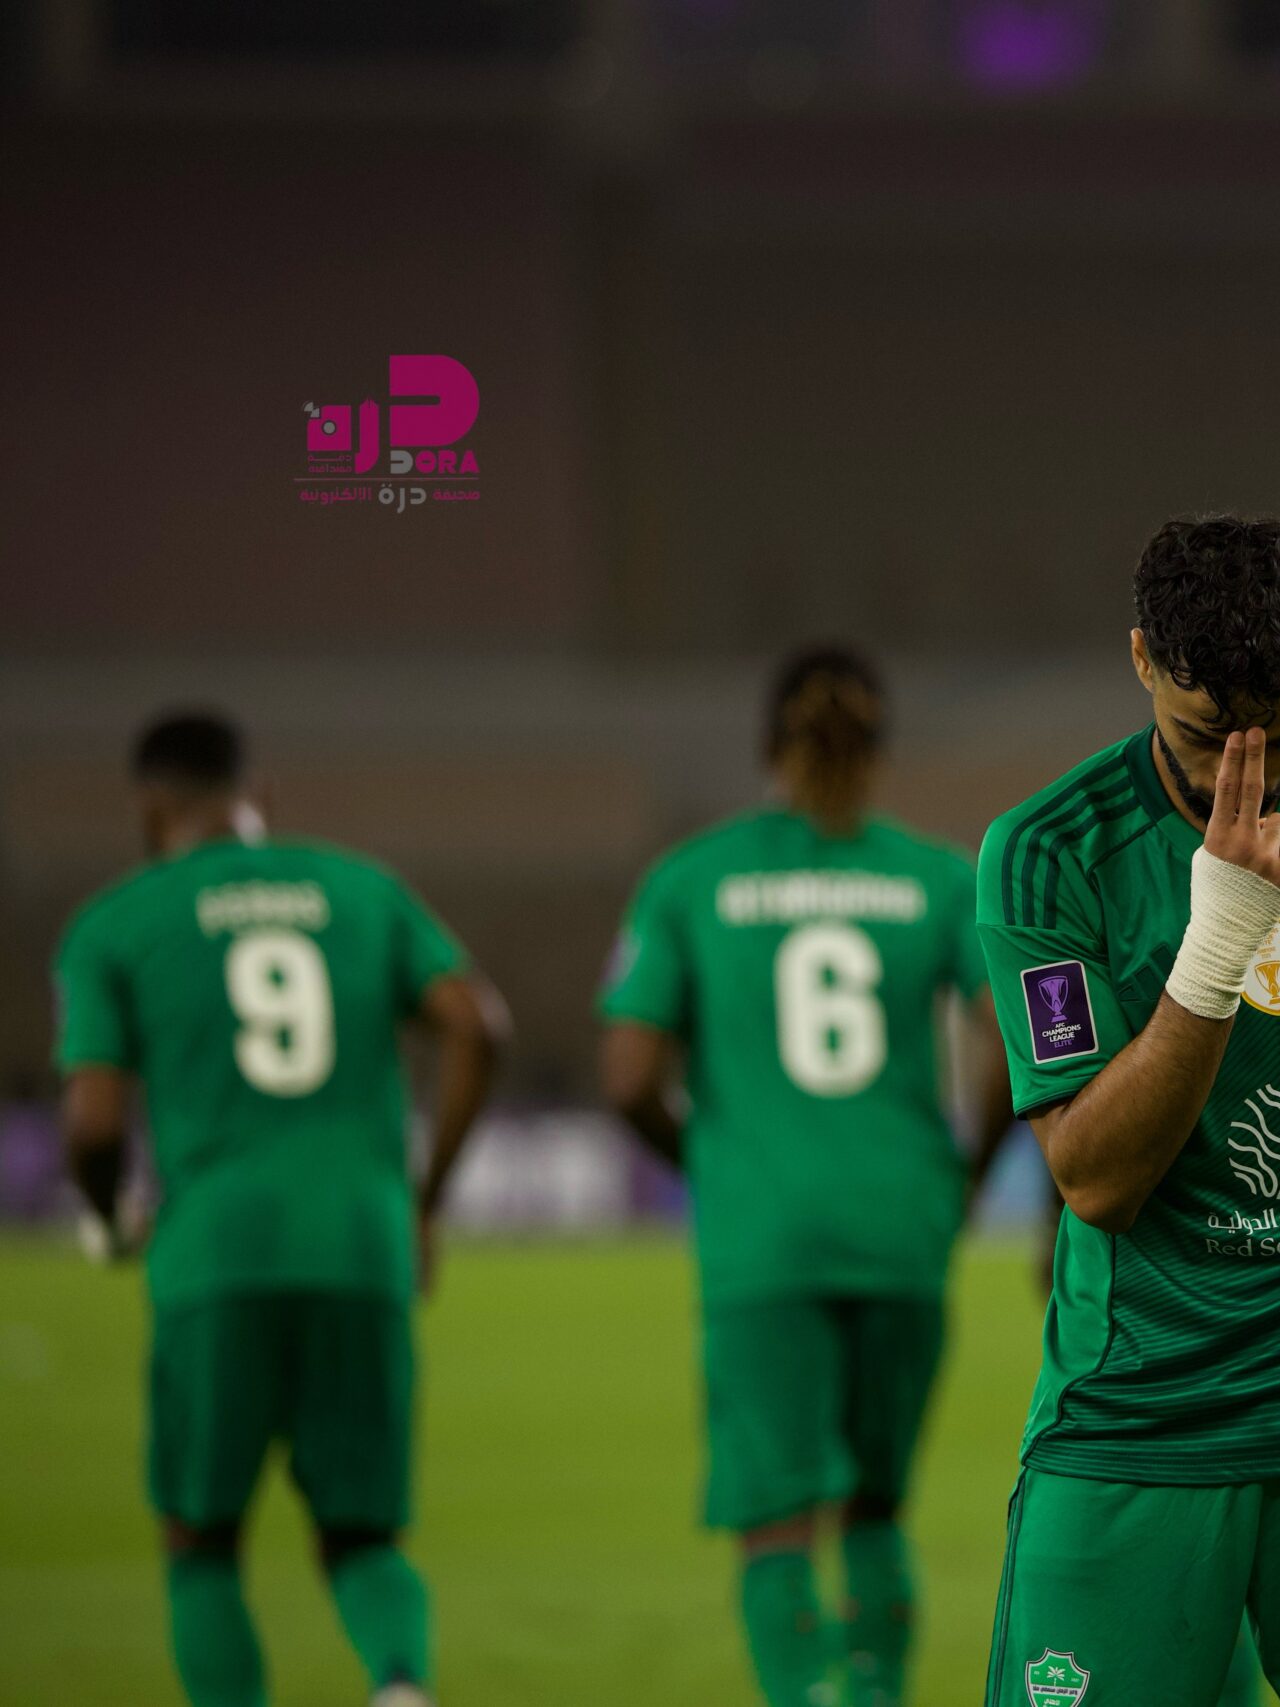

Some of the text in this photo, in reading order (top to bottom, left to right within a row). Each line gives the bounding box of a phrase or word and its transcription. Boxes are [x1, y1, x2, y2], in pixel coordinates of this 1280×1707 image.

[226, 929, 334, 1097] 9
[775, 922, 887, 1097] 6
[1042, 1023, 1081, 1038] CHAMPIONS
[1049, 1031, 1075, 1043] LEAGUE
[1054, 1039, 1073, 1049] ELITE
[1207, 1207, 1279, 1235] الدولية
[1205, 1238, 1253, 1257] Red
